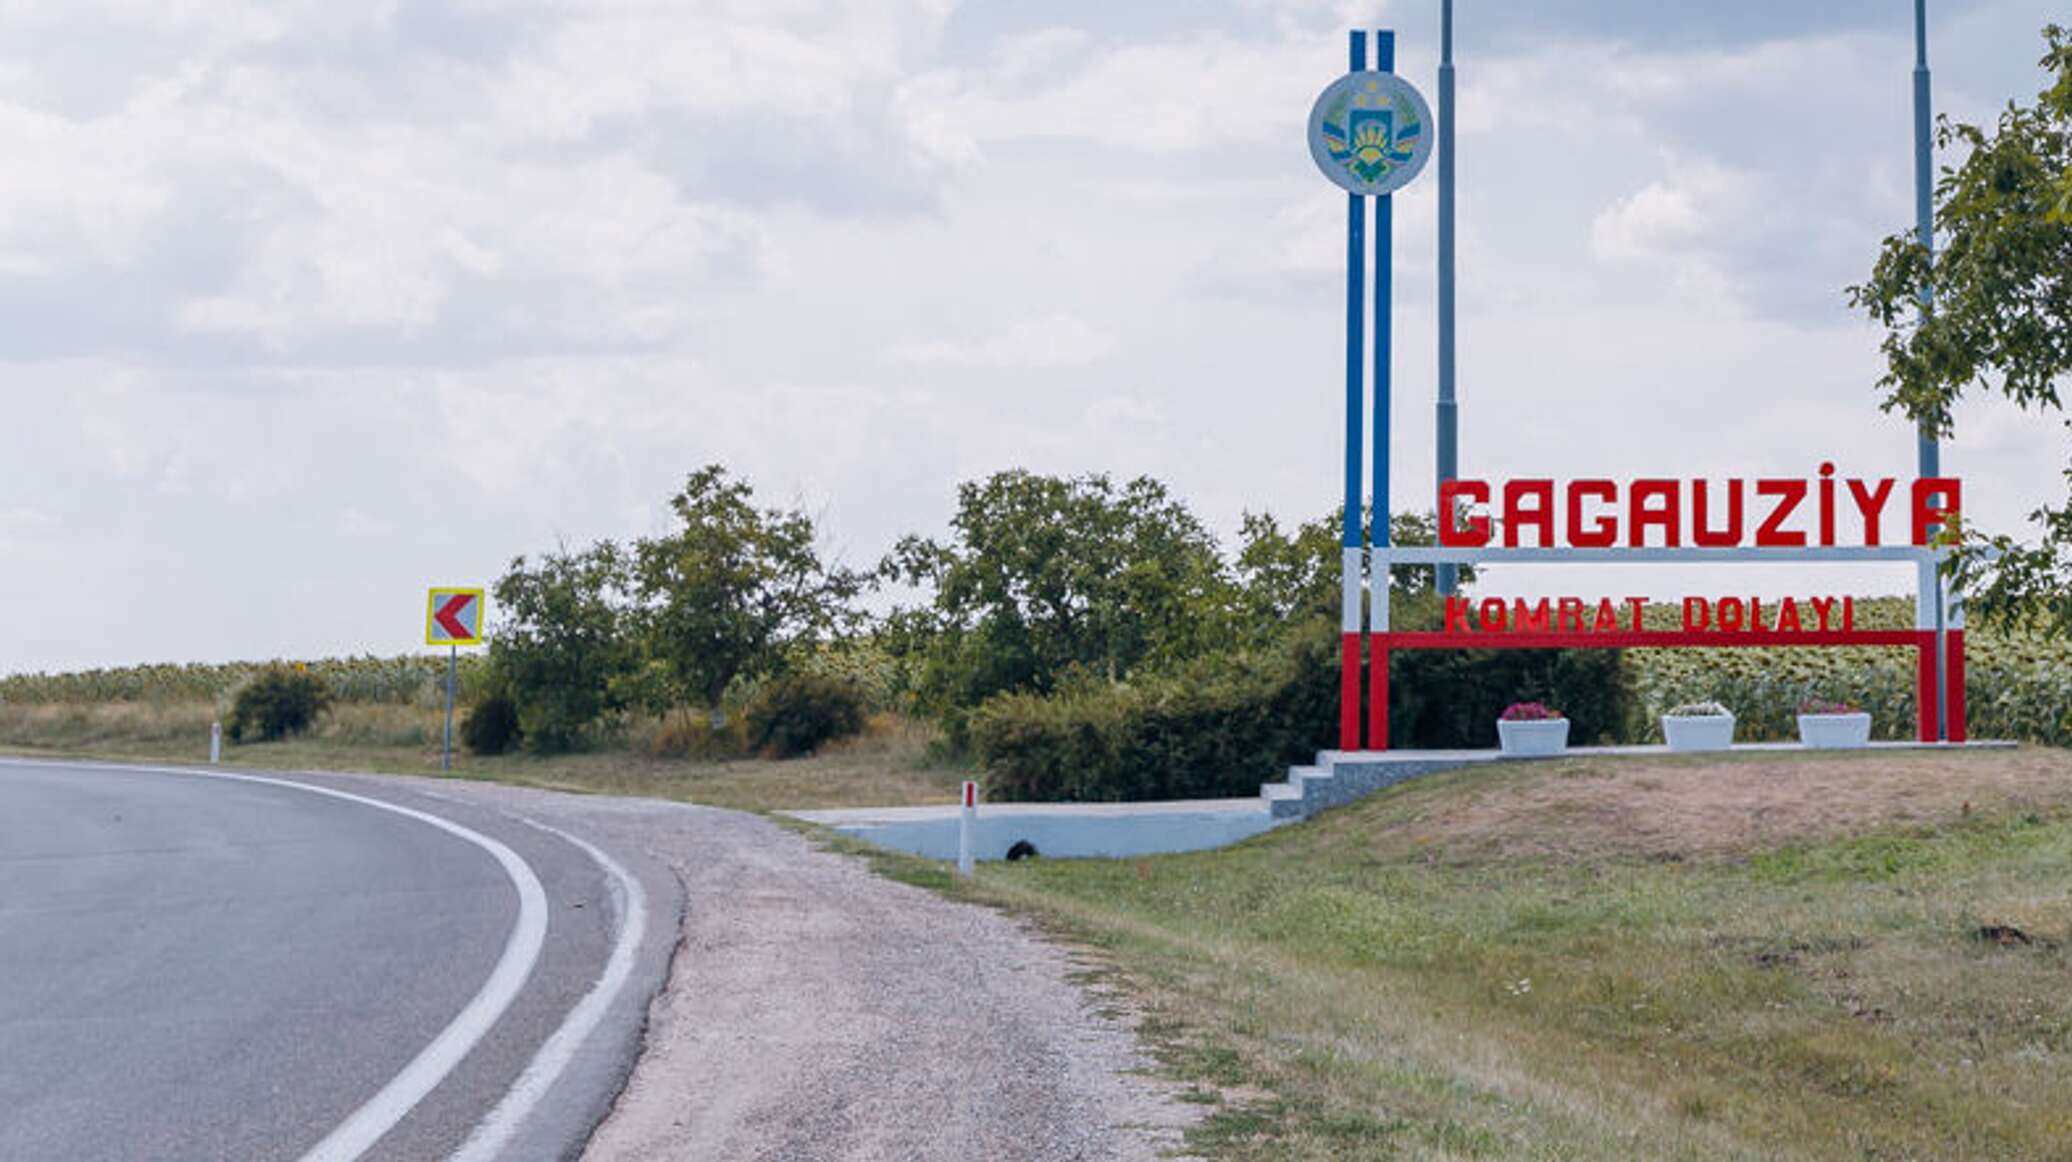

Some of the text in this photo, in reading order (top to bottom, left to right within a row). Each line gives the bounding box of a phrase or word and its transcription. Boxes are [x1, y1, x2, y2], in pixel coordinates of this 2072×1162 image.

[1439, 461, 1962, 547] GAGAUZİYA
[1445, 596, 1854, 632] KOMRAT DOLAYI
